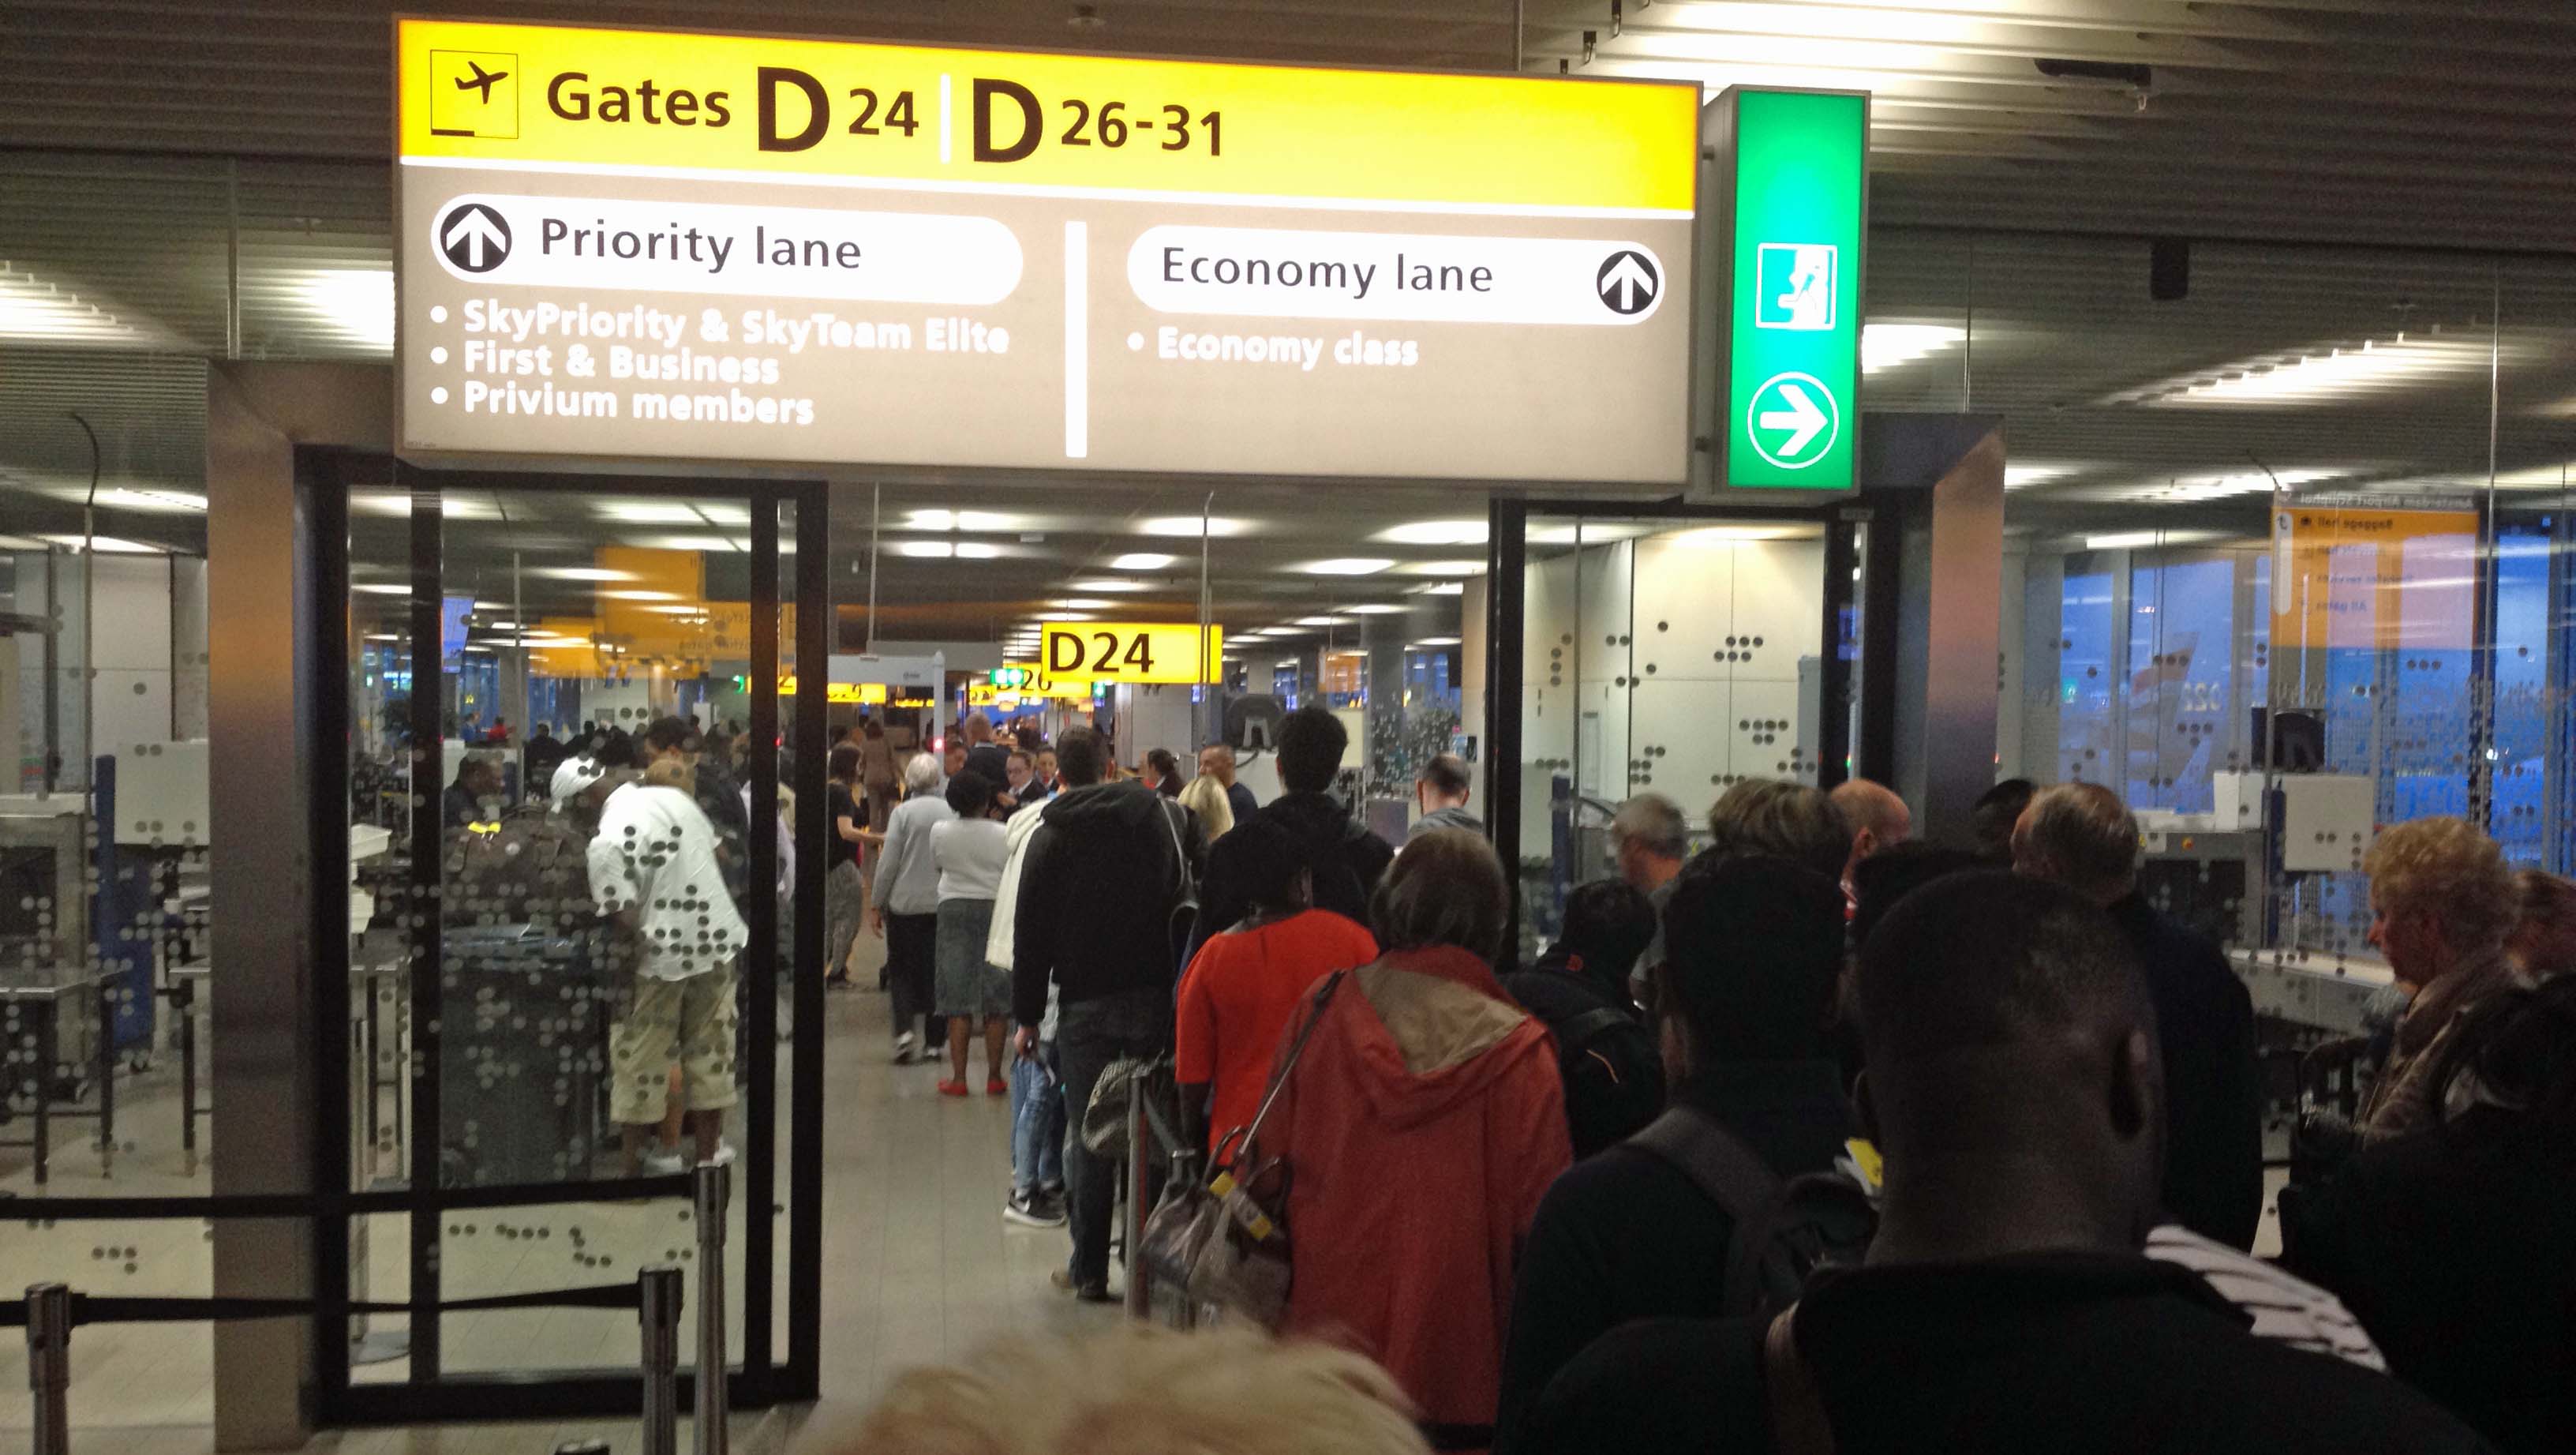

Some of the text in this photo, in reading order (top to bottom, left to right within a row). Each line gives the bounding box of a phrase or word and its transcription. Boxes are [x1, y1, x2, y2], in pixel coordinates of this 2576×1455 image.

[547, 66, 1220, 163] Gates D 24 D 26-31
[542, 218, 860, 274] Priority lane
[1163, 246, 1493, 300] Economy lane
[464, 298, 1010, 354] SkyPriority & SkyTeam Elite
[1158, 326, 1419, 371] Economy class
[464, 339, 780, 384] First & Business
[464, 381, 814, 425] Privium members
[1050, 632, 1155, 673] D24
